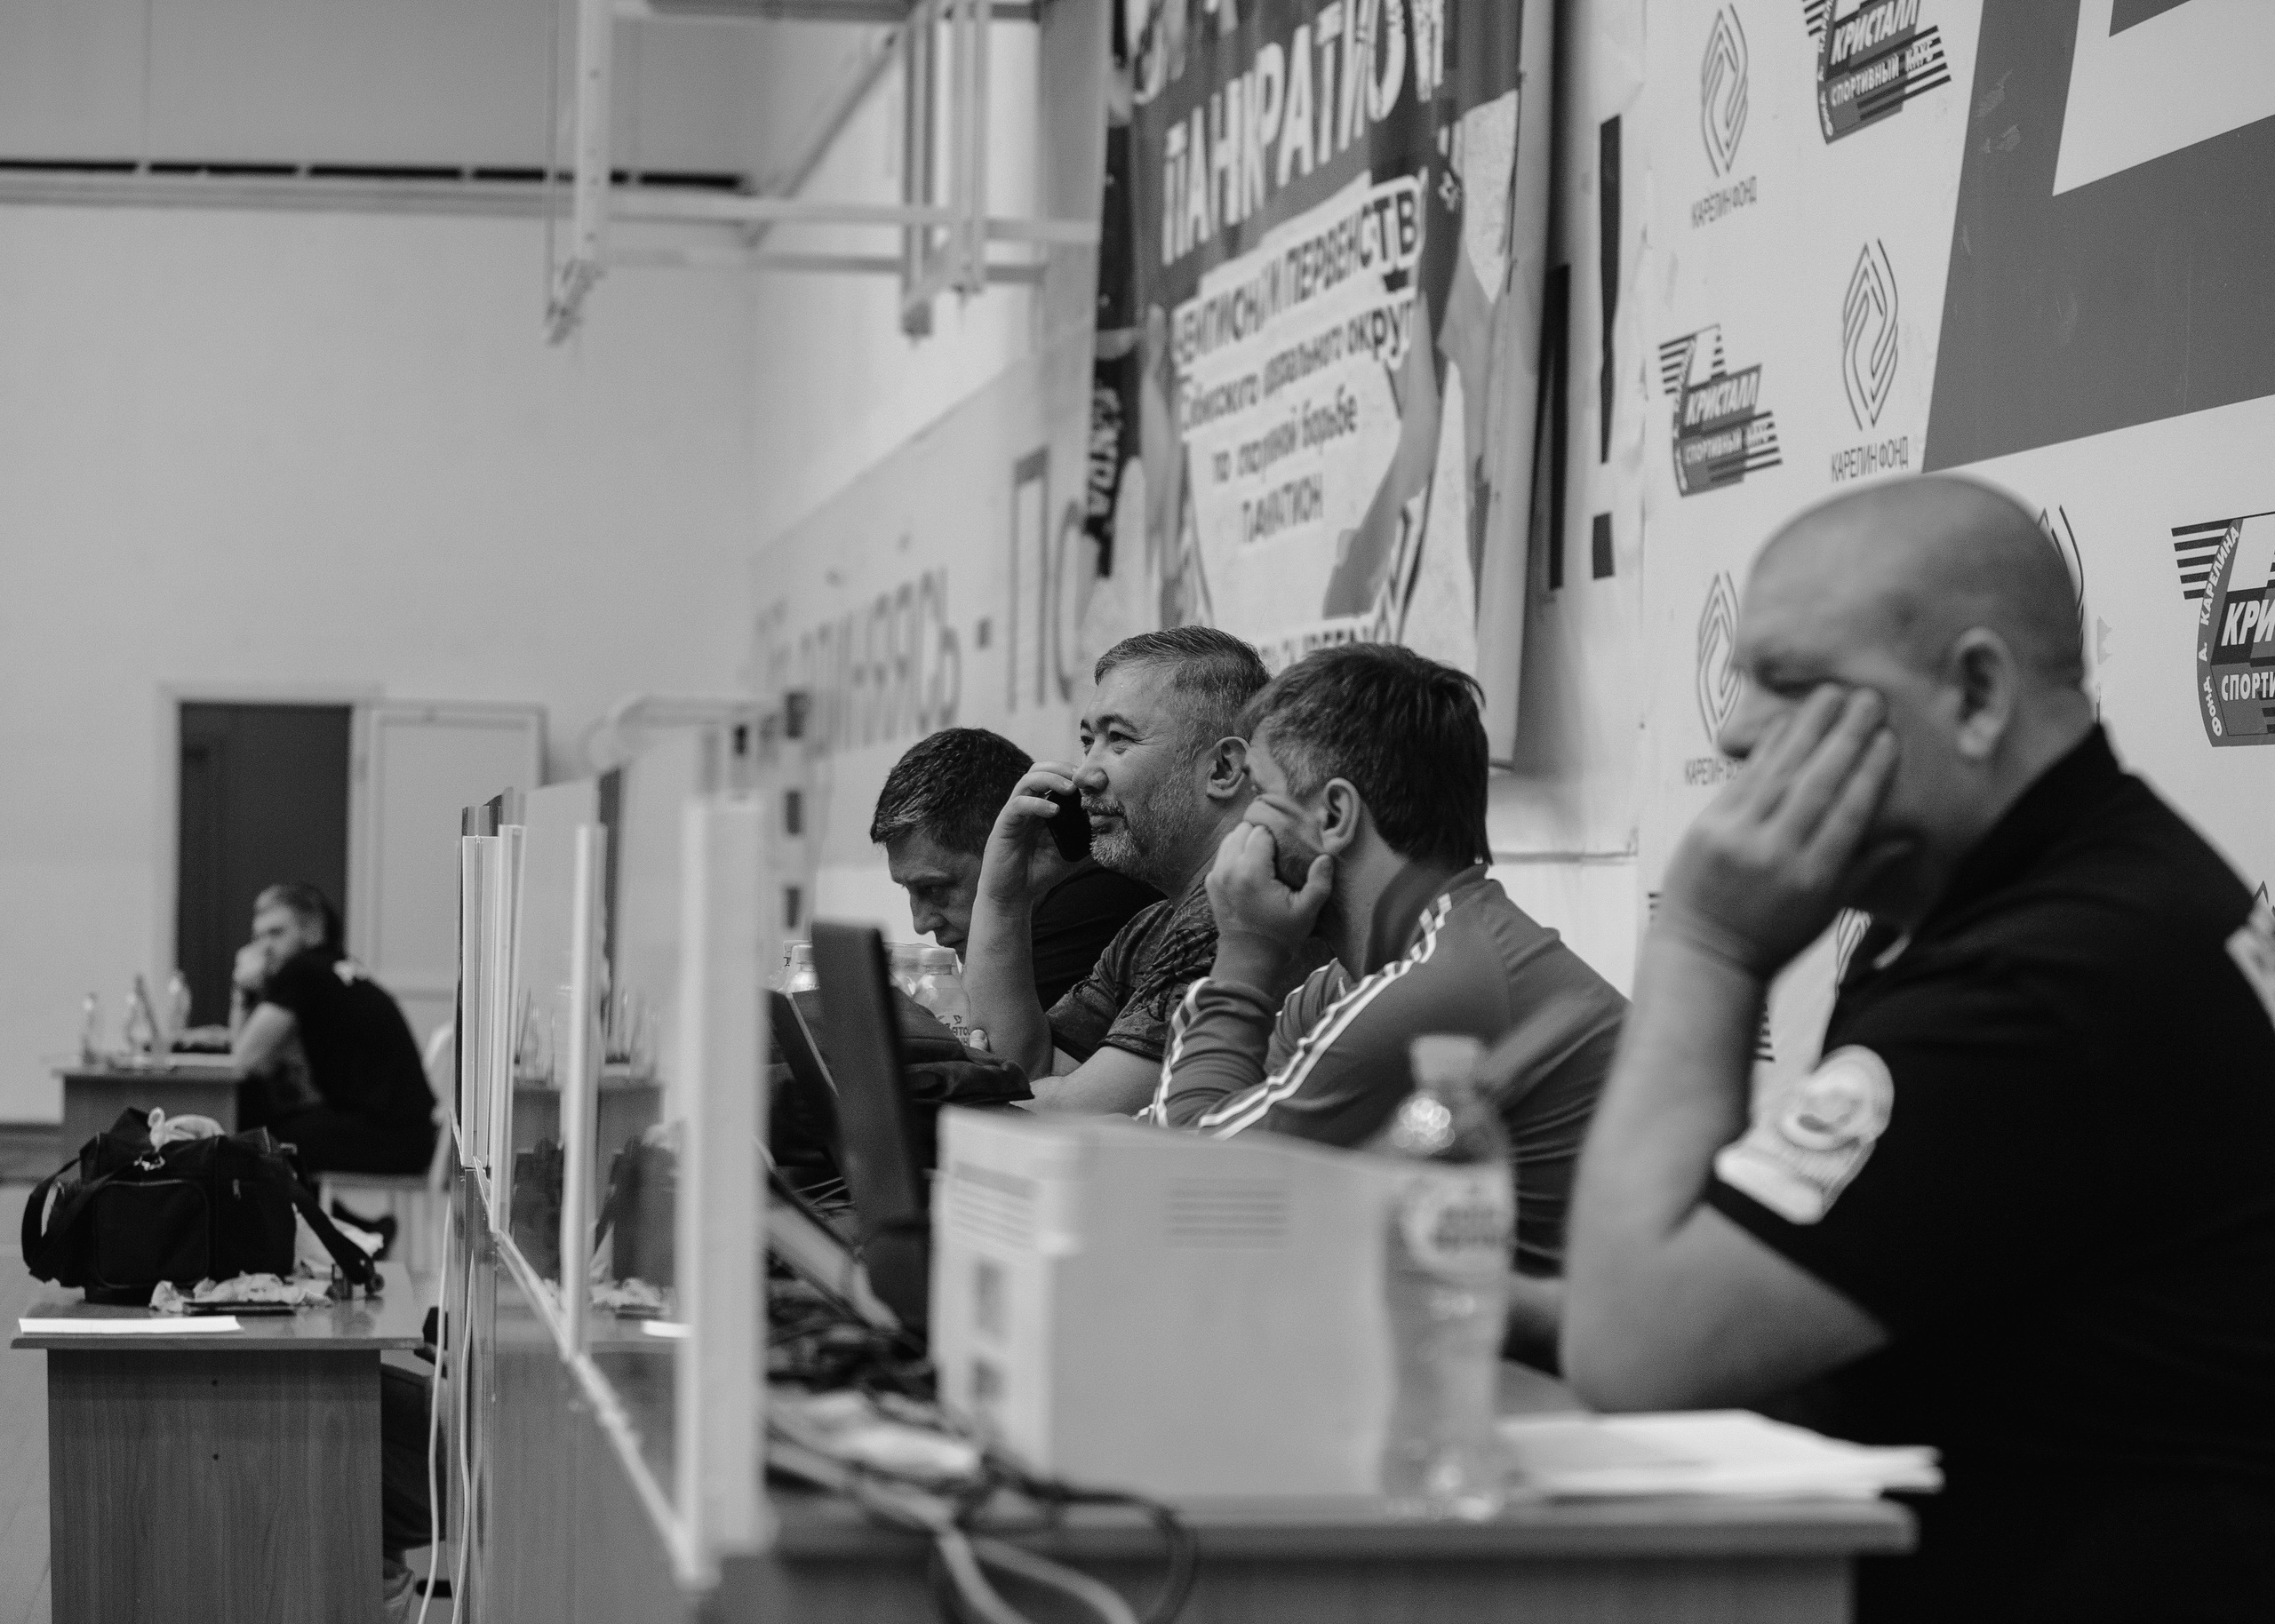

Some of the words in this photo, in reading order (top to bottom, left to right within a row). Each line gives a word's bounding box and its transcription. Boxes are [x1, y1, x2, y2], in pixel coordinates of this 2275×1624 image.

[1830, 0, 1917, 66] КРИСТАЛЛ
[1831, 52, 1900, 107] СПОРТИВНЫЙ
[1831, 442, 1878, 482] КАРЕЛИН
[1879, 435, 1909, 470] ФОНД
[2199, 525, 2239, 626] КАРЕЛИНА
[2198, 641, 2207, 662] А.
[2202, 675, 2223, 737] ФОНД
